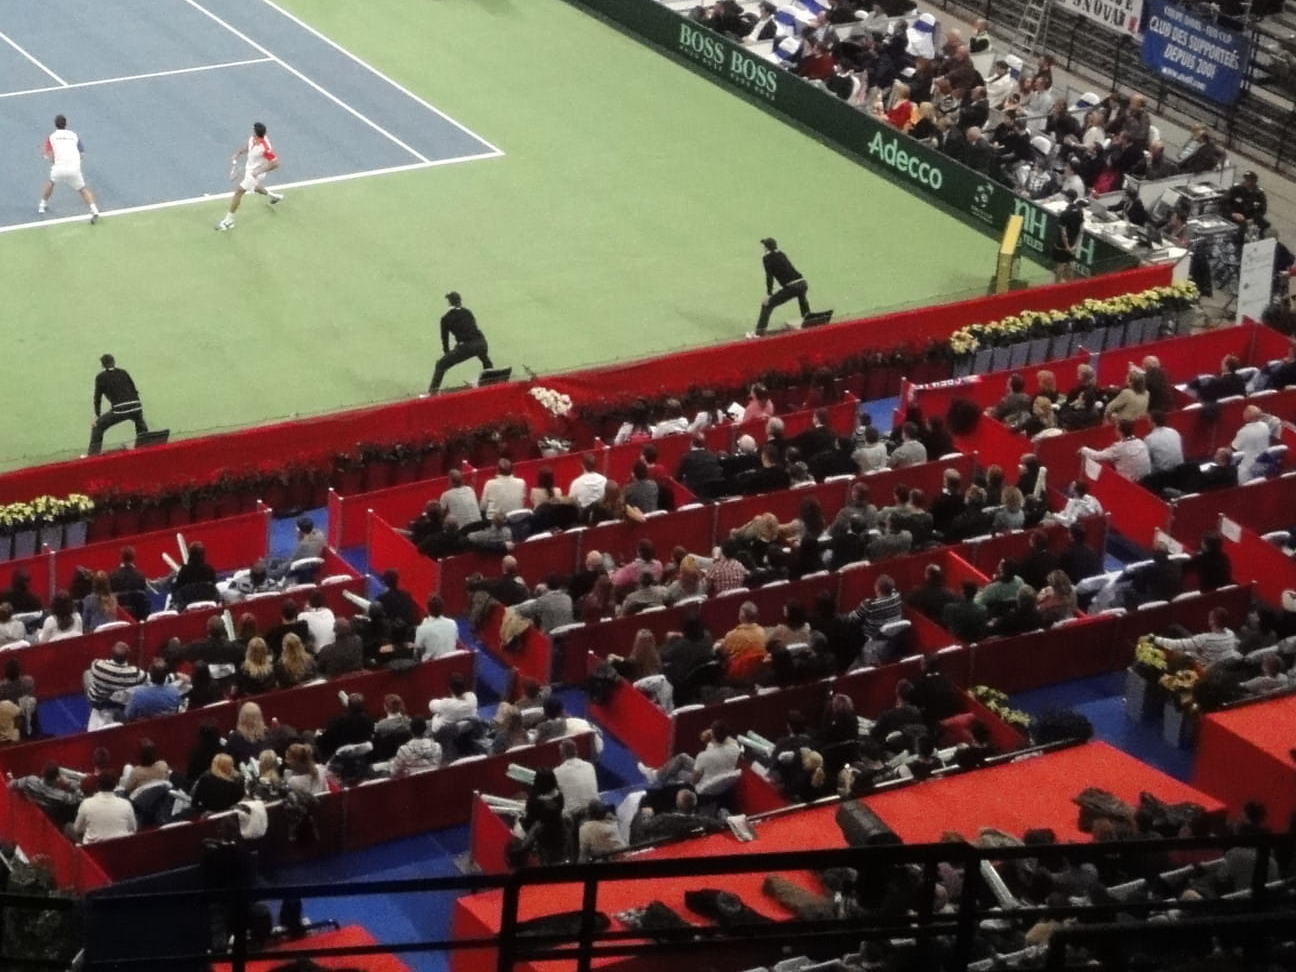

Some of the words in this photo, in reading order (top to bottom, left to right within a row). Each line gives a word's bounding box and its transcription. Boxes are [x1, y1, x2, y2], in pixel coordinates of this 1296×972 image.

[679, 23, 725, 64] BOSS
[731, 50, 778, 93] BOSS
[867, 131, 942, 189] Adecco
